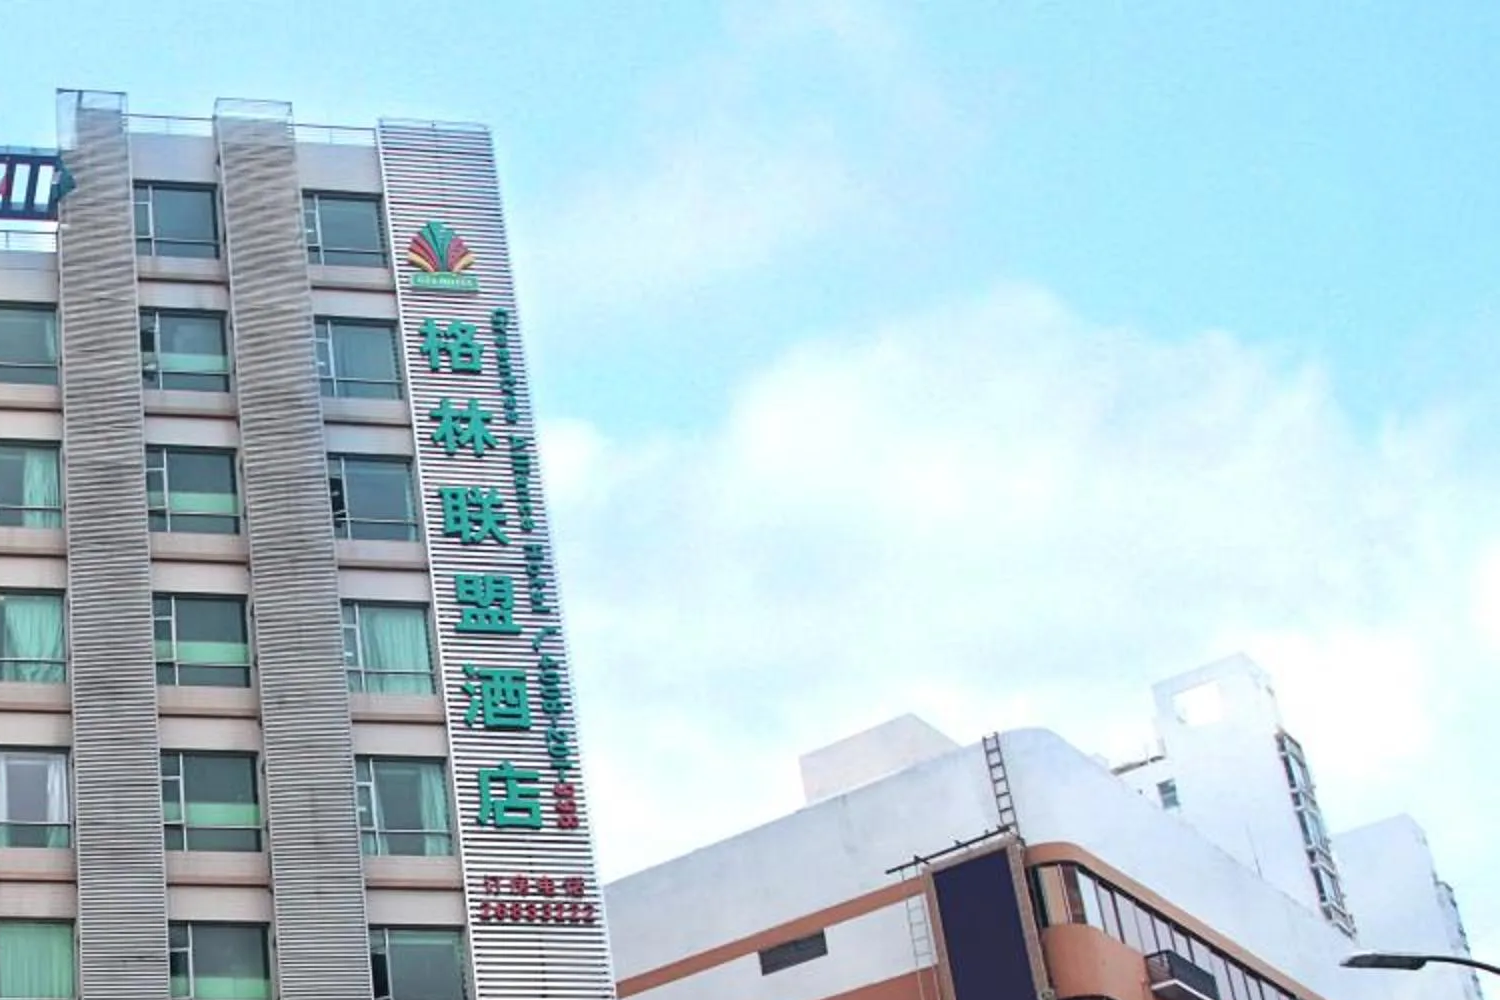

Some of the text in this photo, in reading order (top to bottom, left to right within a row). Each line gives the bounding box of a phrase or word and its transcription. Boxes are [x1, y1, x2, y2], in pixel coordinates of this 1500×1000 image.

[419, 318, 543, 830] 格林联盟酒店
